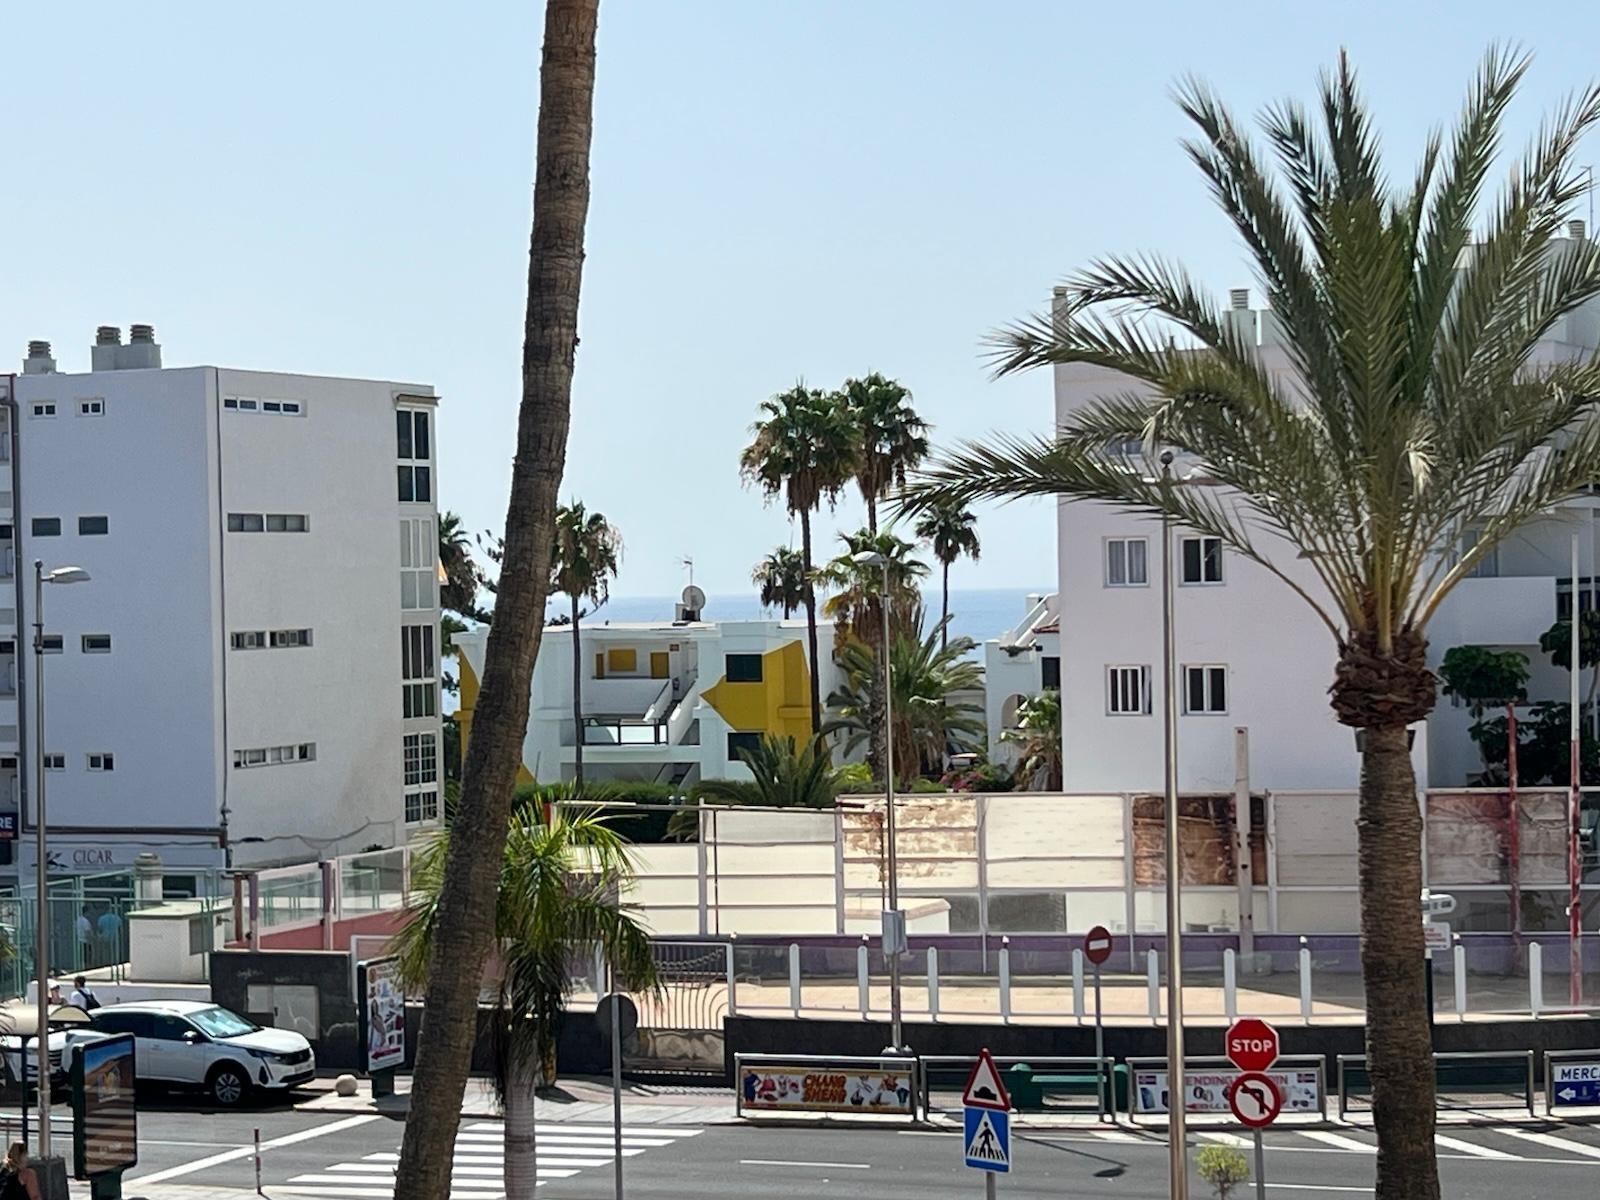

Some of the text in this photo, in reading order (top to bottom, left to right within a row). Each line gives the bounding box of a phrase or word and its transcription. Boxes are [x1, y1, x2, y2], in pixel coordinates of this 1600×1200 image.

[72, 849, 113, 864] CICAR
[1231, 1039, 1273, 1053] STOP
[1561, 1066, 1600, 1080] MERC
[1167, 1075, 1233, 1086] ENDING
